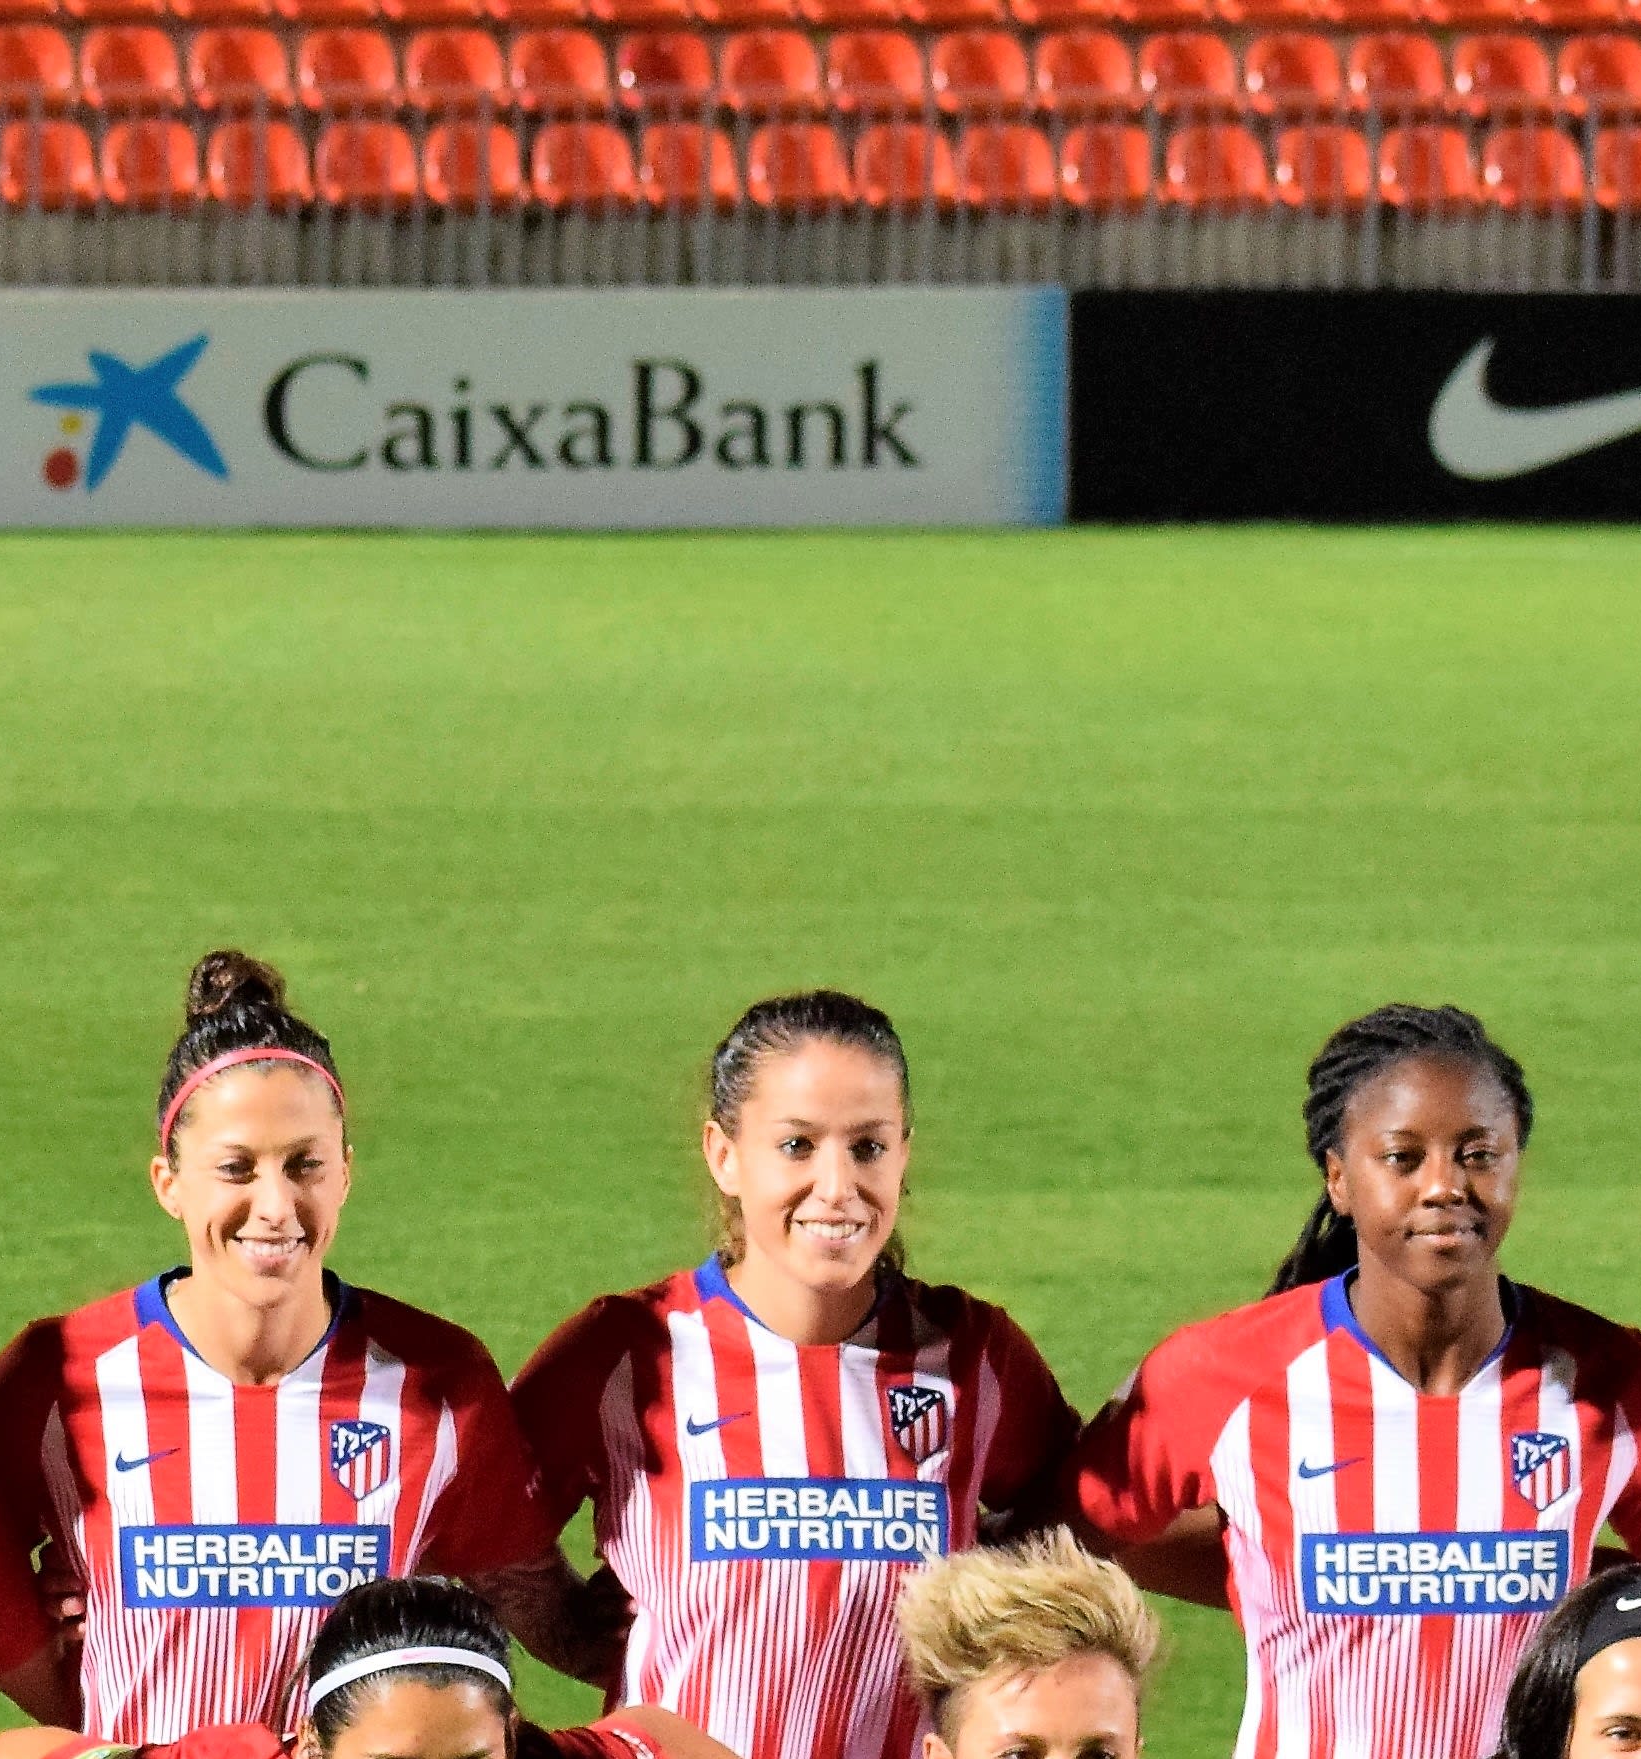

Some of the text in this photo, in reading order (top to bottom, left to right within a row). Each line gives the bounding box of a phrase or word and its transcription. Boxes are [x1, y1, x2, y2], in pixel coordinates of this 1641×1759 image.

[261, 350, 919, 473] CaixaBank
[703, 1486, 939, 1522] HERBALIFE
[132, 1533, 379, 1567] HERBALIFE
[703, 1519, 941, 1554] NUTRITION
[1313, 1540, 1558, 1574] HERBALIFE
[135, 1566, 377, 1599] NUTRITION
[1315, 1572, 1557, 1606] NUTRITION
